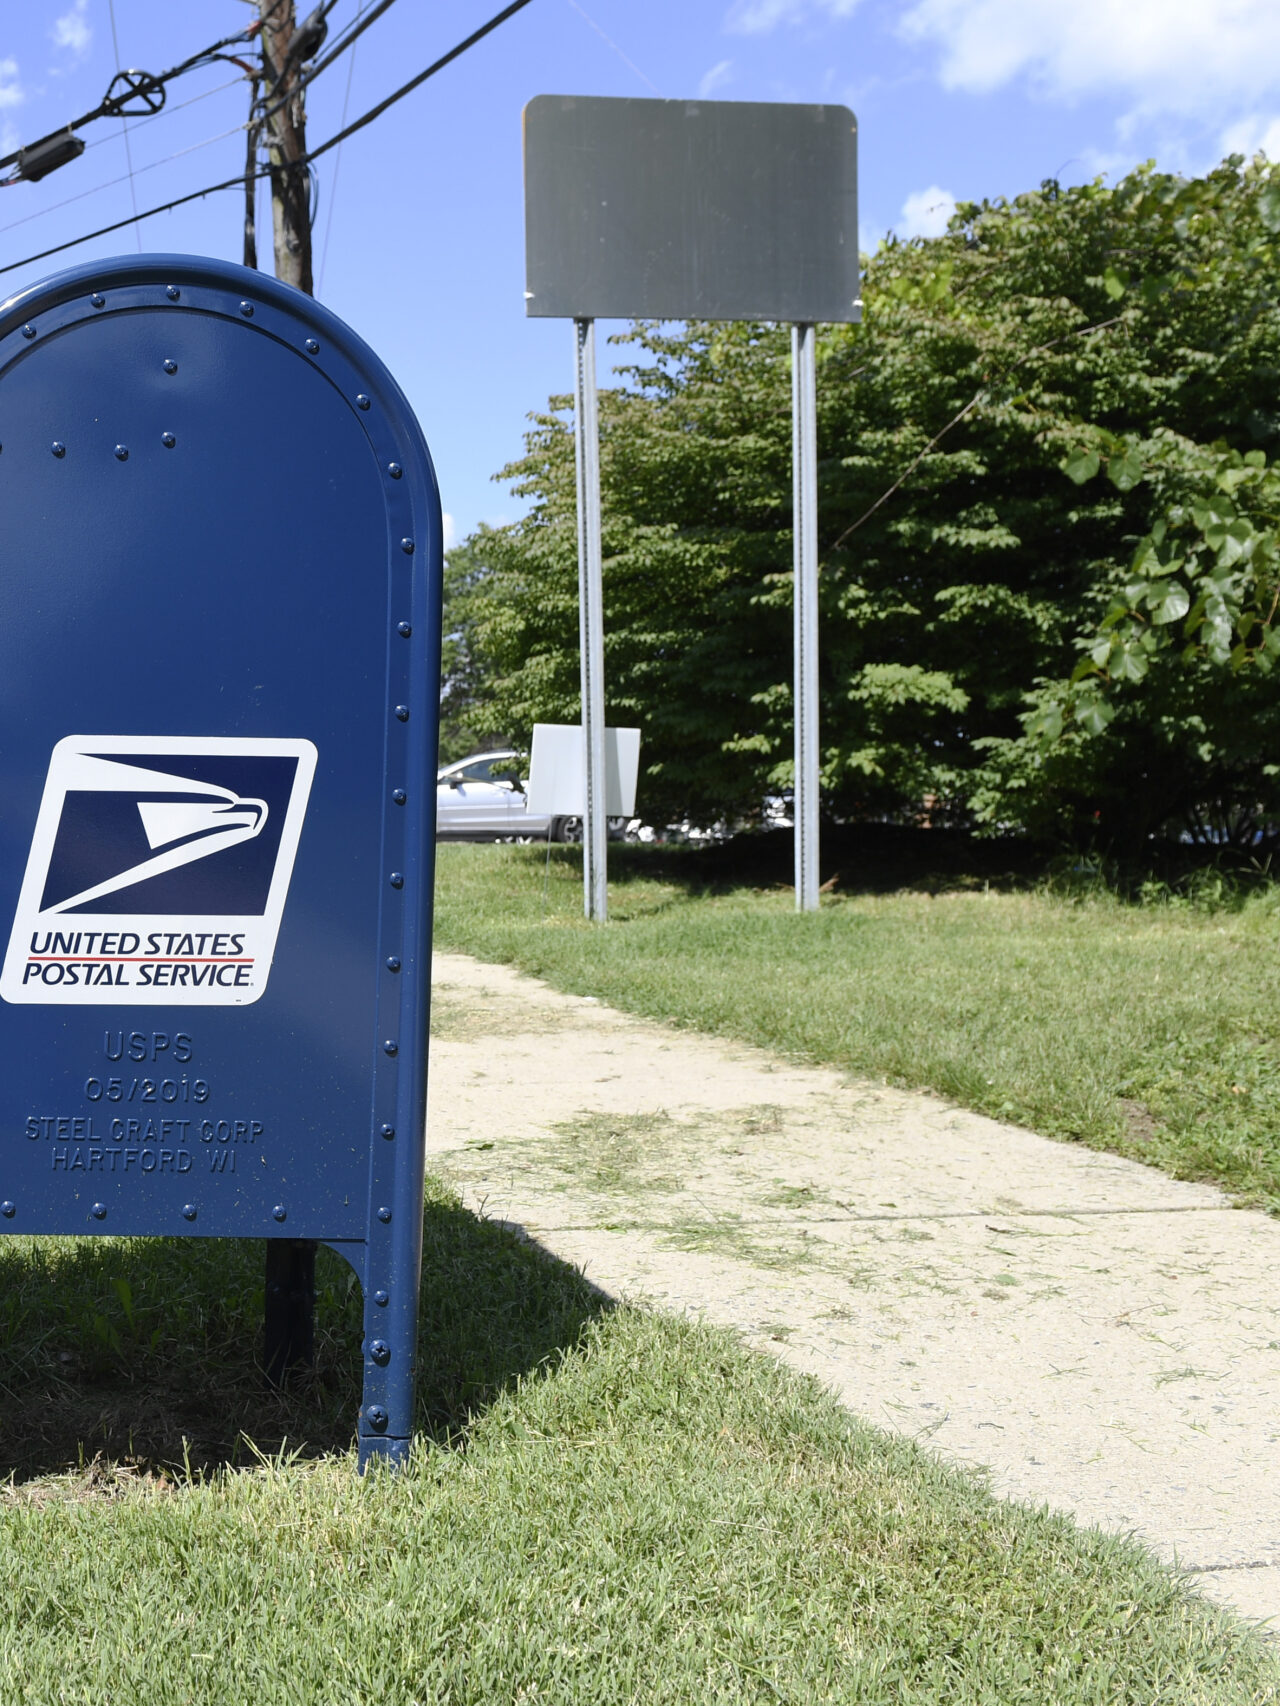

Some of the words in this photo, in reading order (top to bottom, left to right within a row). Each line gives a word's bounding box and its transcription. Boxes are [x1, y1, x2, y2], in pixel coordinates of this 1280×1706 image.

[30, 931, 140, 955] UNITED
[144, 933, 245, 956] STATES
[22, 962, 129, 986] POSTAL
[136, 963, 253, 987] SERVICE
[103, 1031, 193, 1063] USPS
[83, 1077, 210, 1103] 05/2019
[25, 1116, 101, 1141] STEEL
[109, 1118, 191, 1143] CRAFT
[199, 1119, 265, 1144] CORP
[51, 1147, 193, 1173] HARTFORD
[206, 1149, 236, 1173] WI
